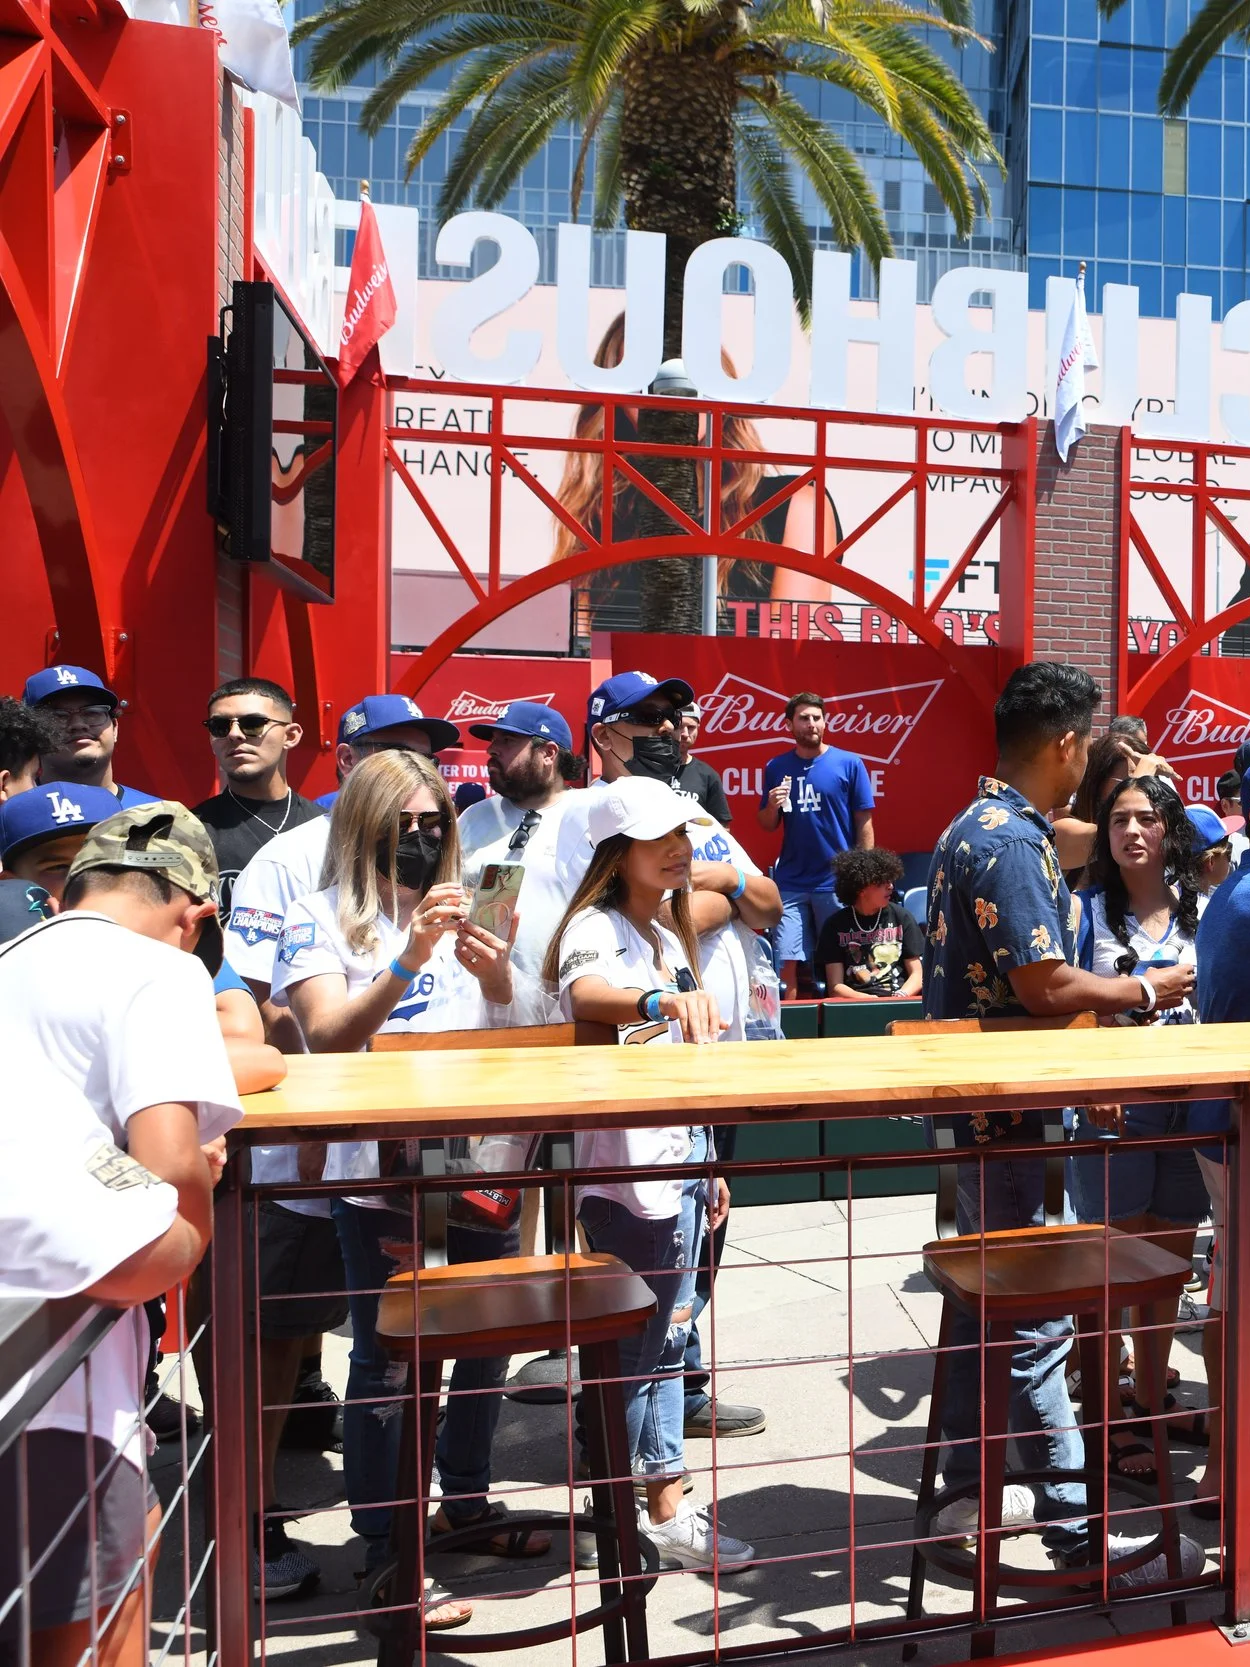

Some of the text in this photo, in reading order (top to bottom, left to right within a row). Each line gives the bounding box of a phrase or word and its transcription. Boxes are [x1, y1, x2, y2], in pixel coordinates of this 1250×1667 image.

[958, 560, 1000, 595] FT
[727, 601, 845, 642] THIS
[54, 666, 79, 685] LA
[697, 694, 914, 734] Bueiser
[461, 764, 478, 778] TO
[47, 791, 84, 824] LA
[796, 776, 822, 813] LA
[232, 916, 281, 934] CHAMPIONS
